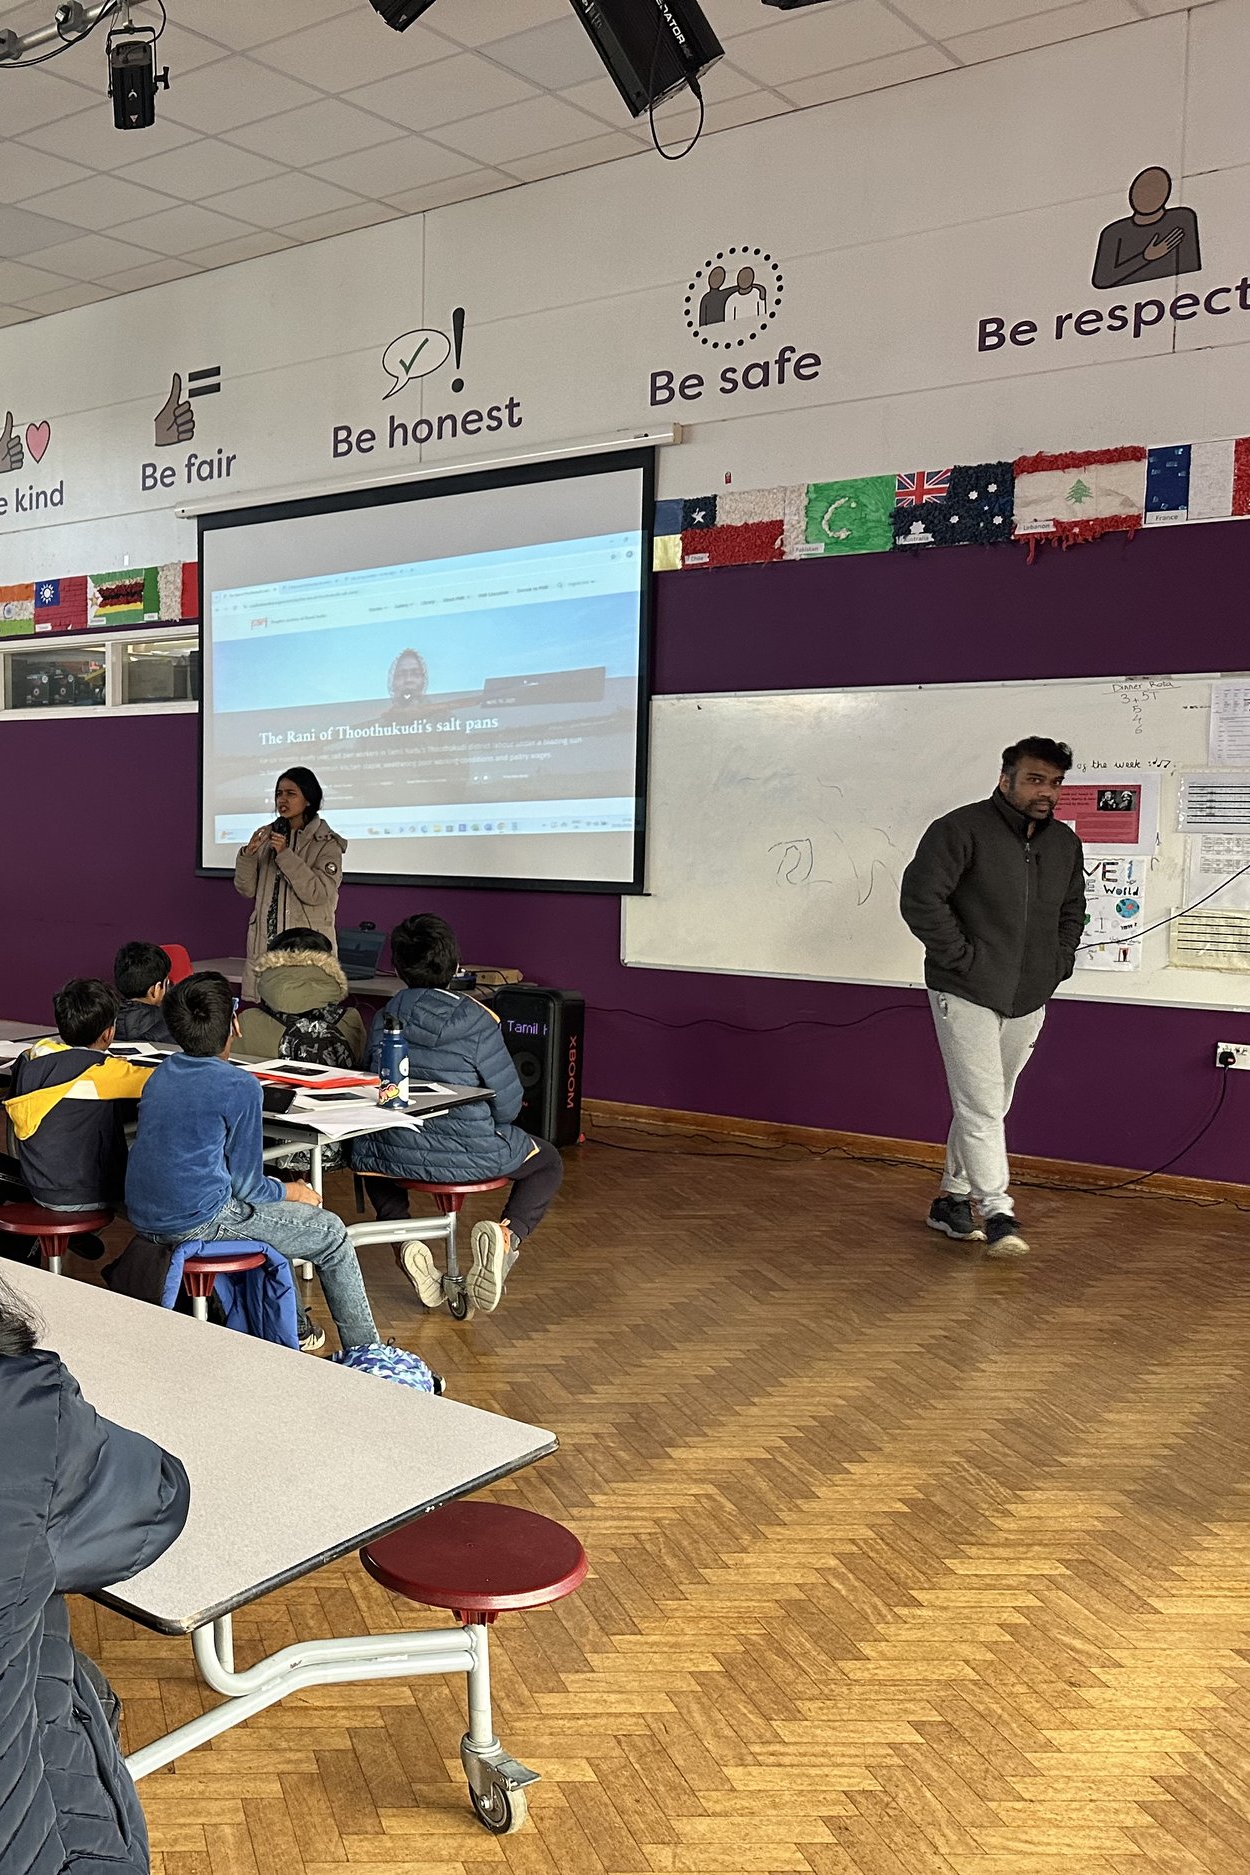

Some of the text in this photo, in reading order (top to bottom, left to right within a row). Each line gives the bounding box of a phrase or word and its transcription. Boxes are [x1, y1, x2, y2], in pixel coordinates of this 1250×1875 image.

[978, 276, 1250, 352] Be respect
[650, 347, 822, 406] Be safe
[333, 397, 523, 458] Be honest
[142, 448, 236, 491] Be fair
[16, 481, 63, 512] kind
[1023, 523, 1050, 531] Lebanon
[1112, 680, 1173, 693] Dinner Rota
[1121, 693, 1131, 704] 3
[1132, 714, 1142, 724] 4
[258, 716, 499, 745] The Rani of Thoothukudi's salt pans
[1134, 725, 1143, 734] 6
[1091, 759, 1108, 769] the
[1114, 758, 1142, 769] week
[1104, 884, 1140, 896] World
[507, 1020, 539, 1036] Tamil
[566, 1034, 578, 1109] XBOOM
